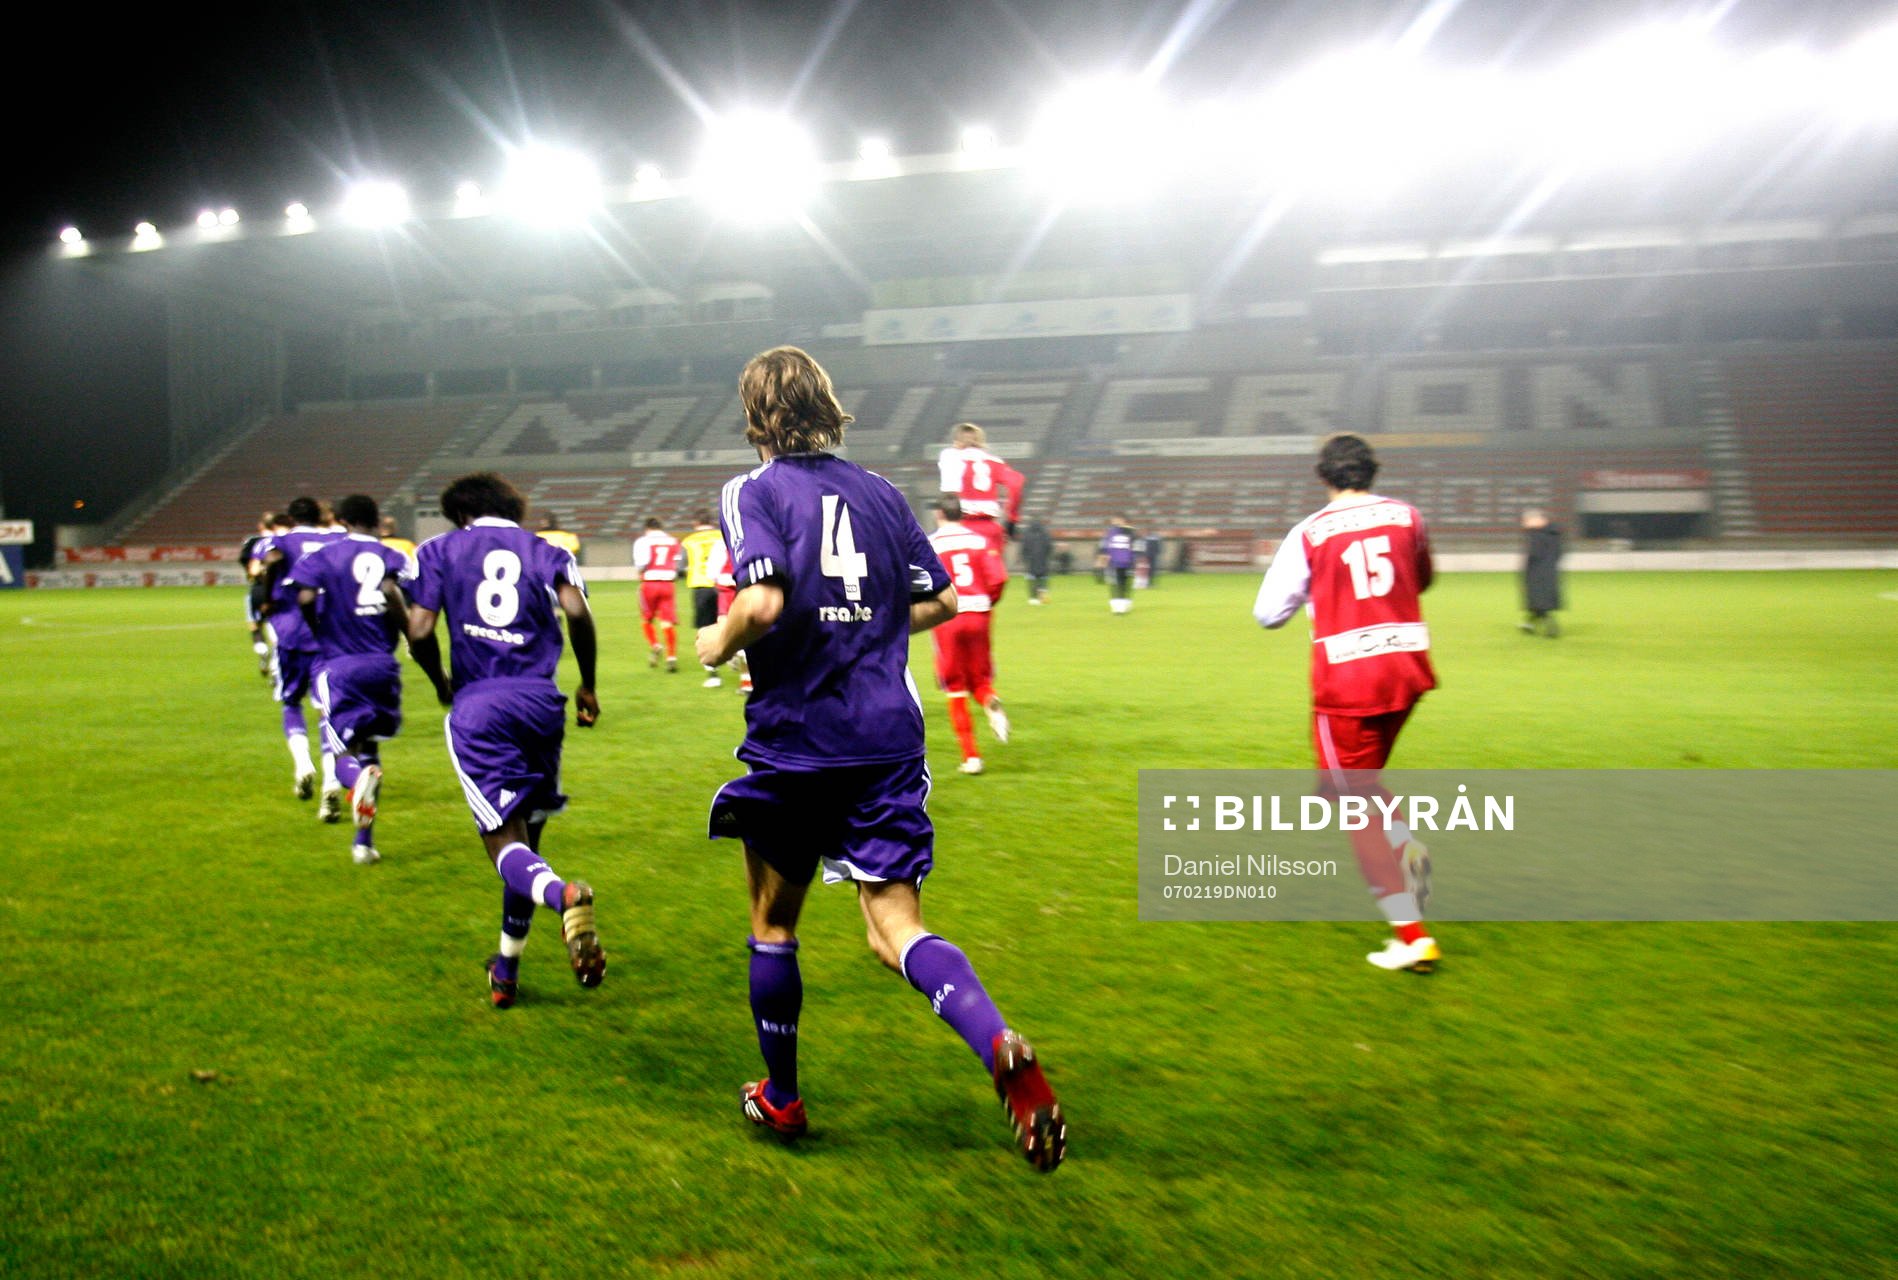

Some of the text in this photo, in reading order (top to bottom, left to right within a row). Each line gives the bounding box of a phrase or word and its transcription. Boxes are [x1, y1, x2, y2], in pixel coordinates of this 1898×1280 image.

[352, 551, 387, 606] 2
[820, 494, 868, 601] 4
[951, 553, 974, 587] 5
[1340, 535, 1395, 600] 15
[475, 549, 522, 627] 8
